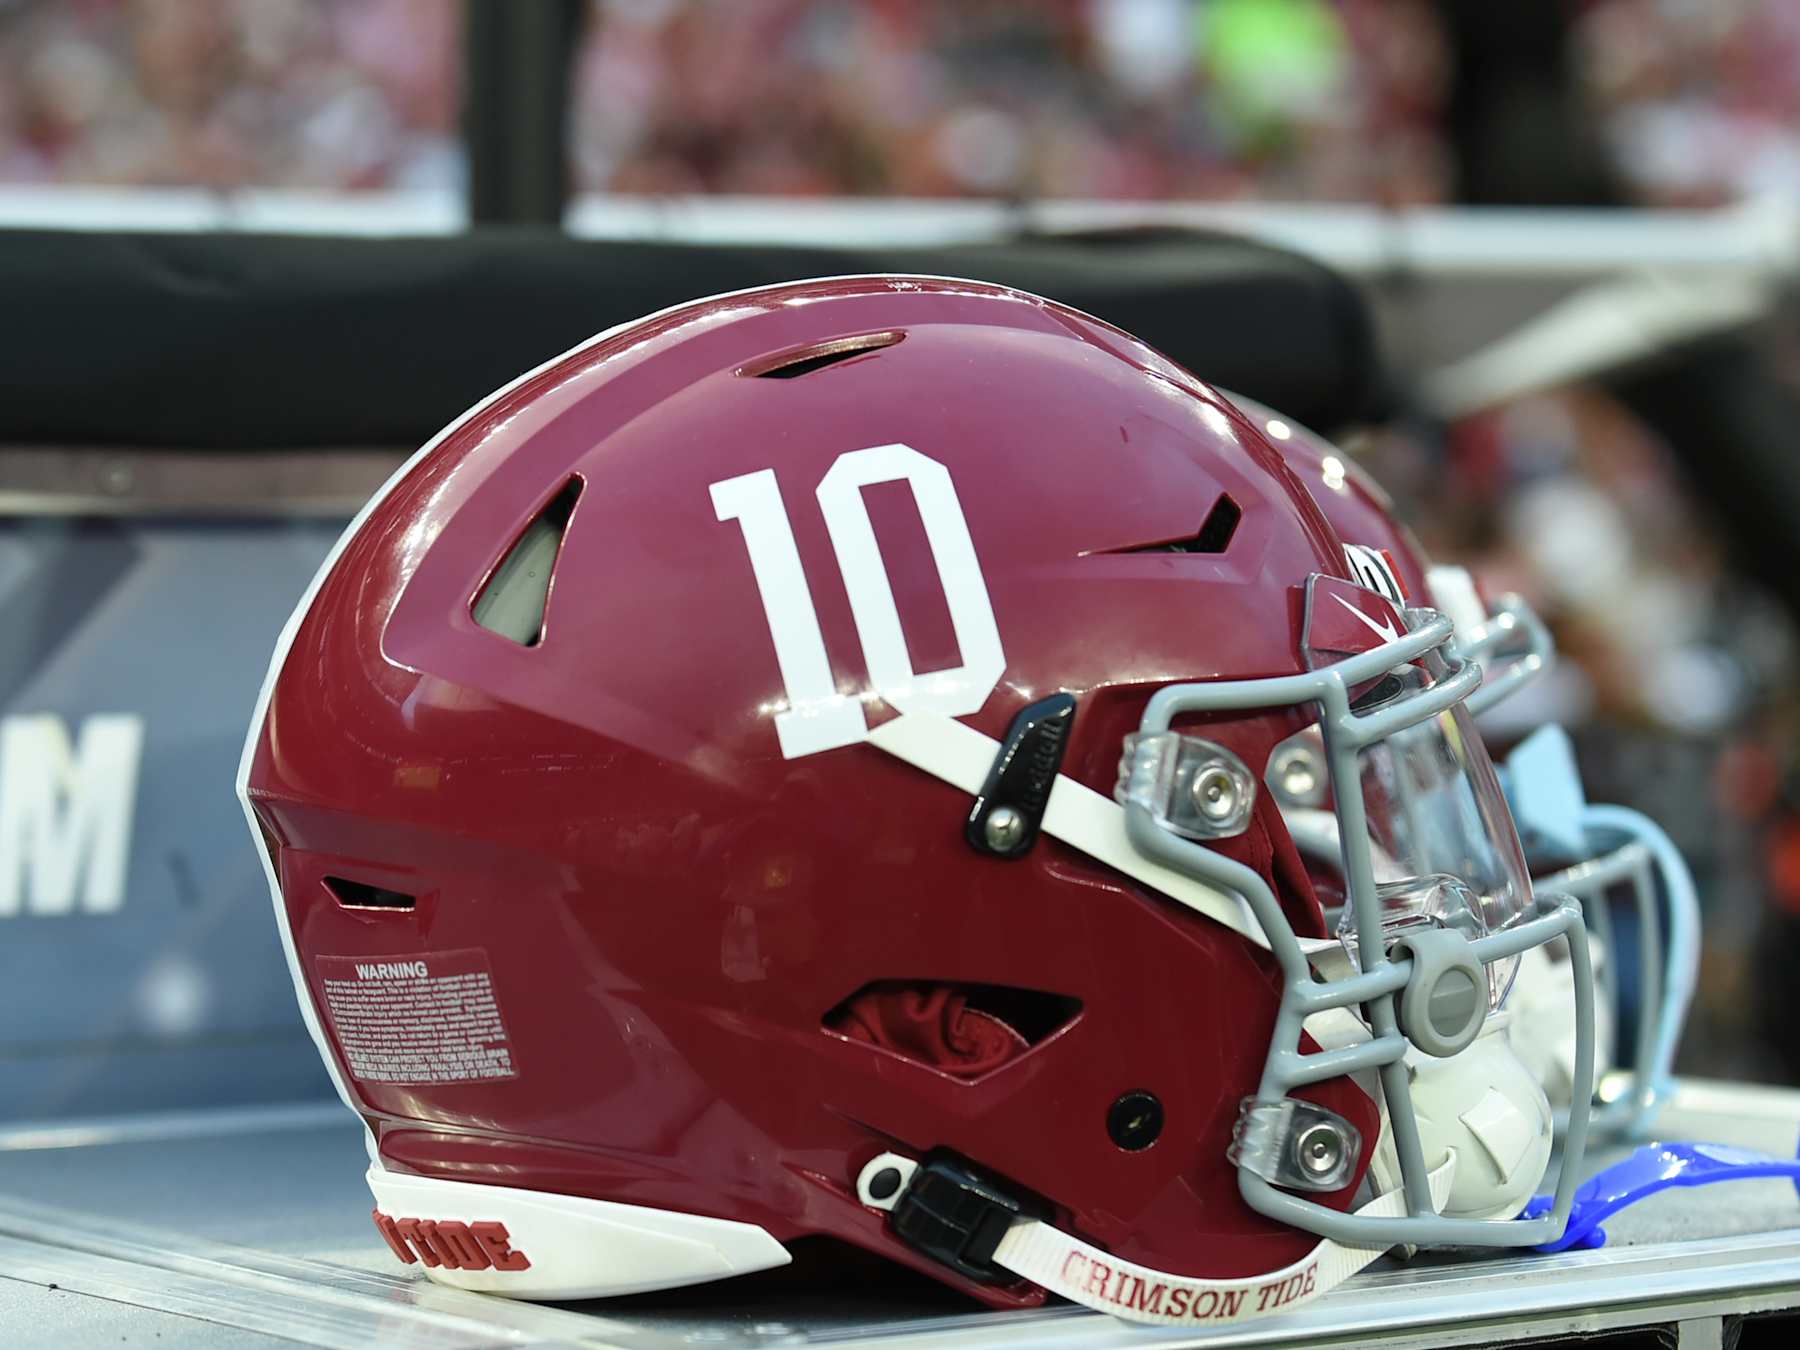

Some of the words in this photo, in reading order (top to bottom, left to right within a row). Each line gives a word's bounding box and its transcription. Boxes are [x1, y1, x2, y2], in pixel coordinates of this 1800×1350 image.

[708, 443, 1007, 760] 10
[355, 961, 428, 980] WARNING
[1061, 1250, 1248, 1319] CRIMSON
[1256, 1261, 1318, 1312] TIDE
